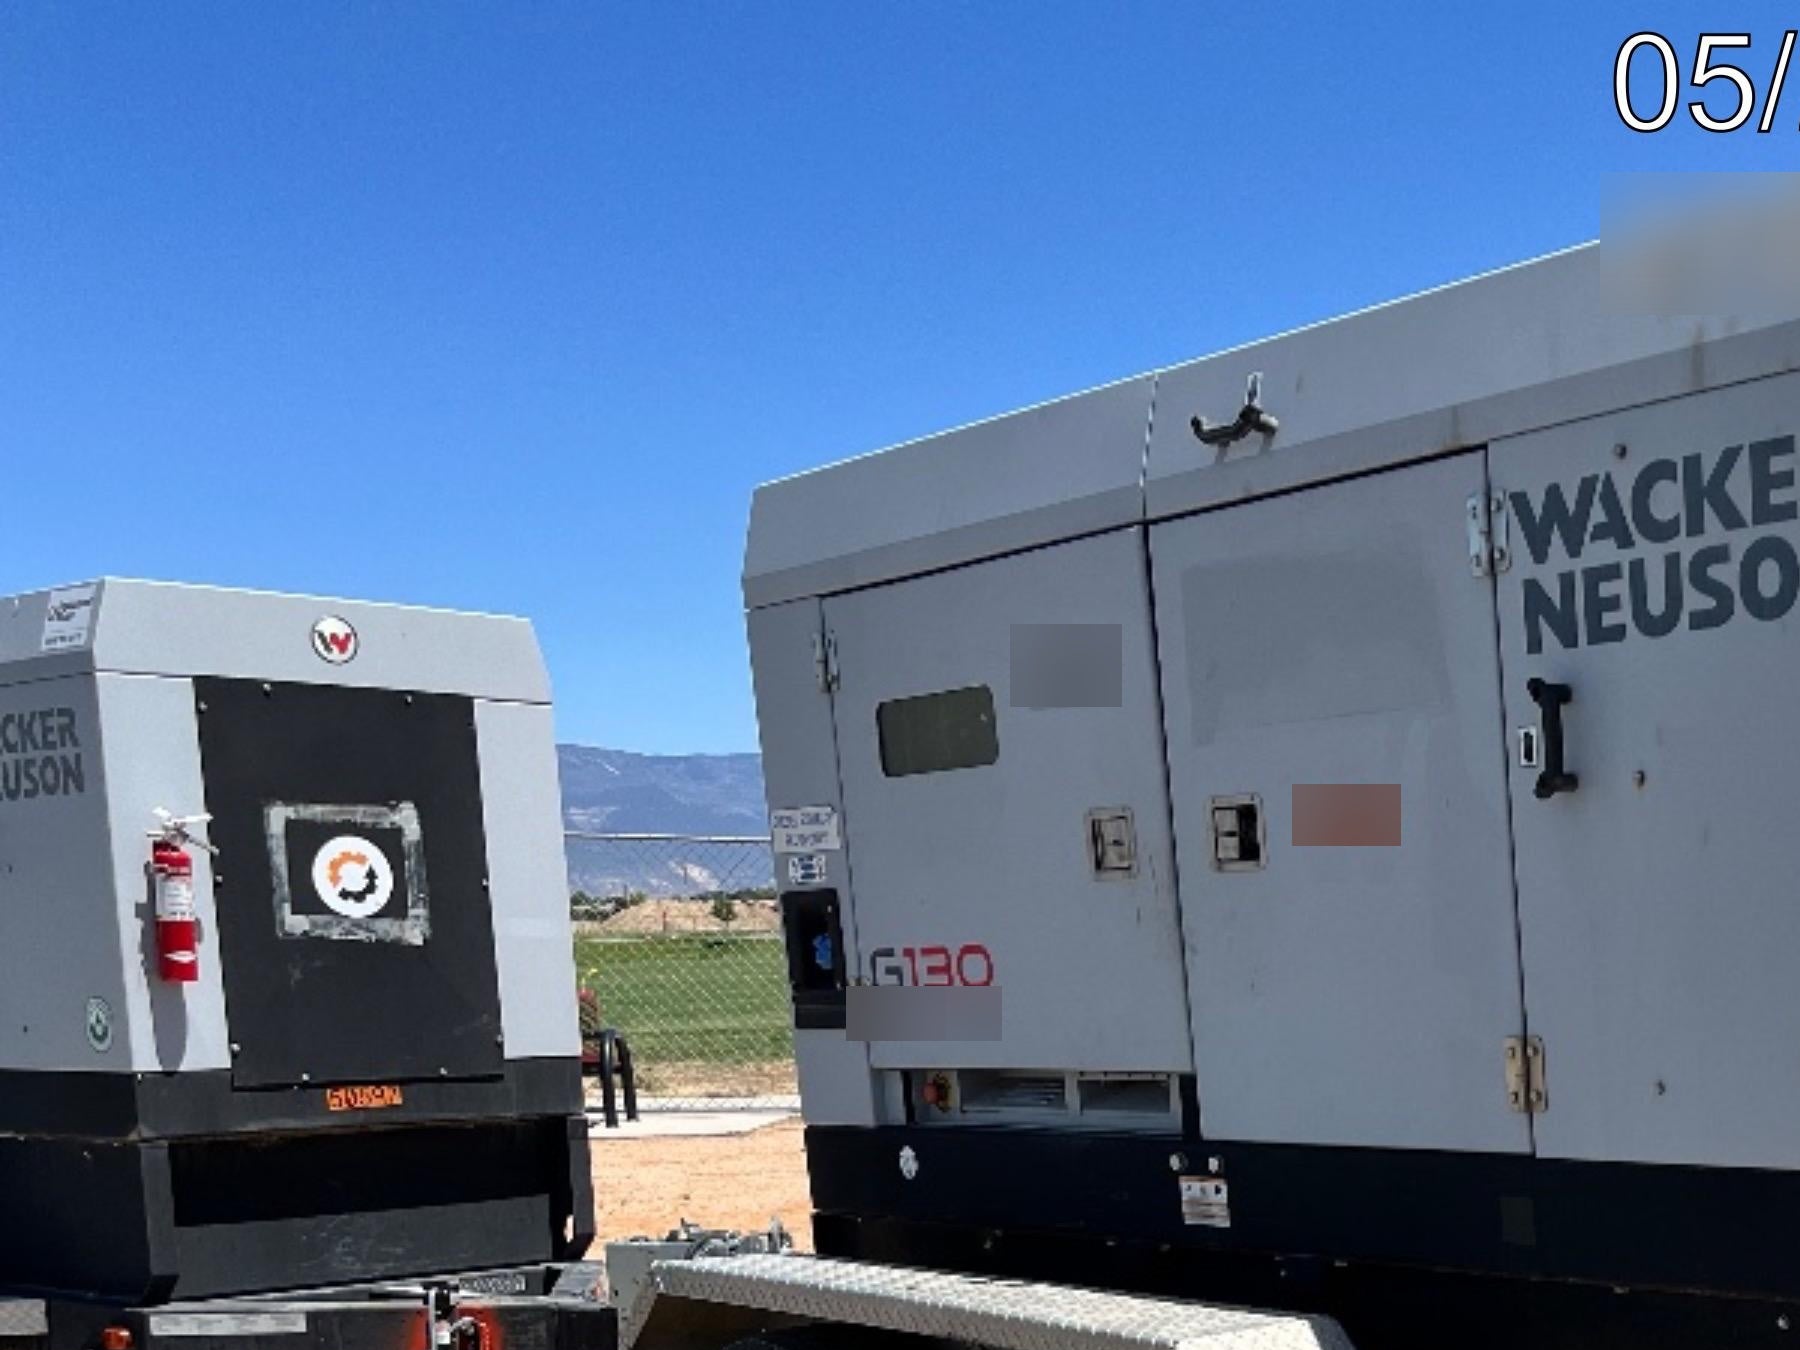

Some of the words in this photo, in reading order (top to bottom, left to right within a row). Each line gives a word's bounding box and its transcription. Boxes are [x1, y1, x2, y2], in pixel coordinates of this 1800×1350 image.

[0, 707, 80, 755] CKER
[0, 752, 85, 801] USON
[870, 944, 994, 987] G130
